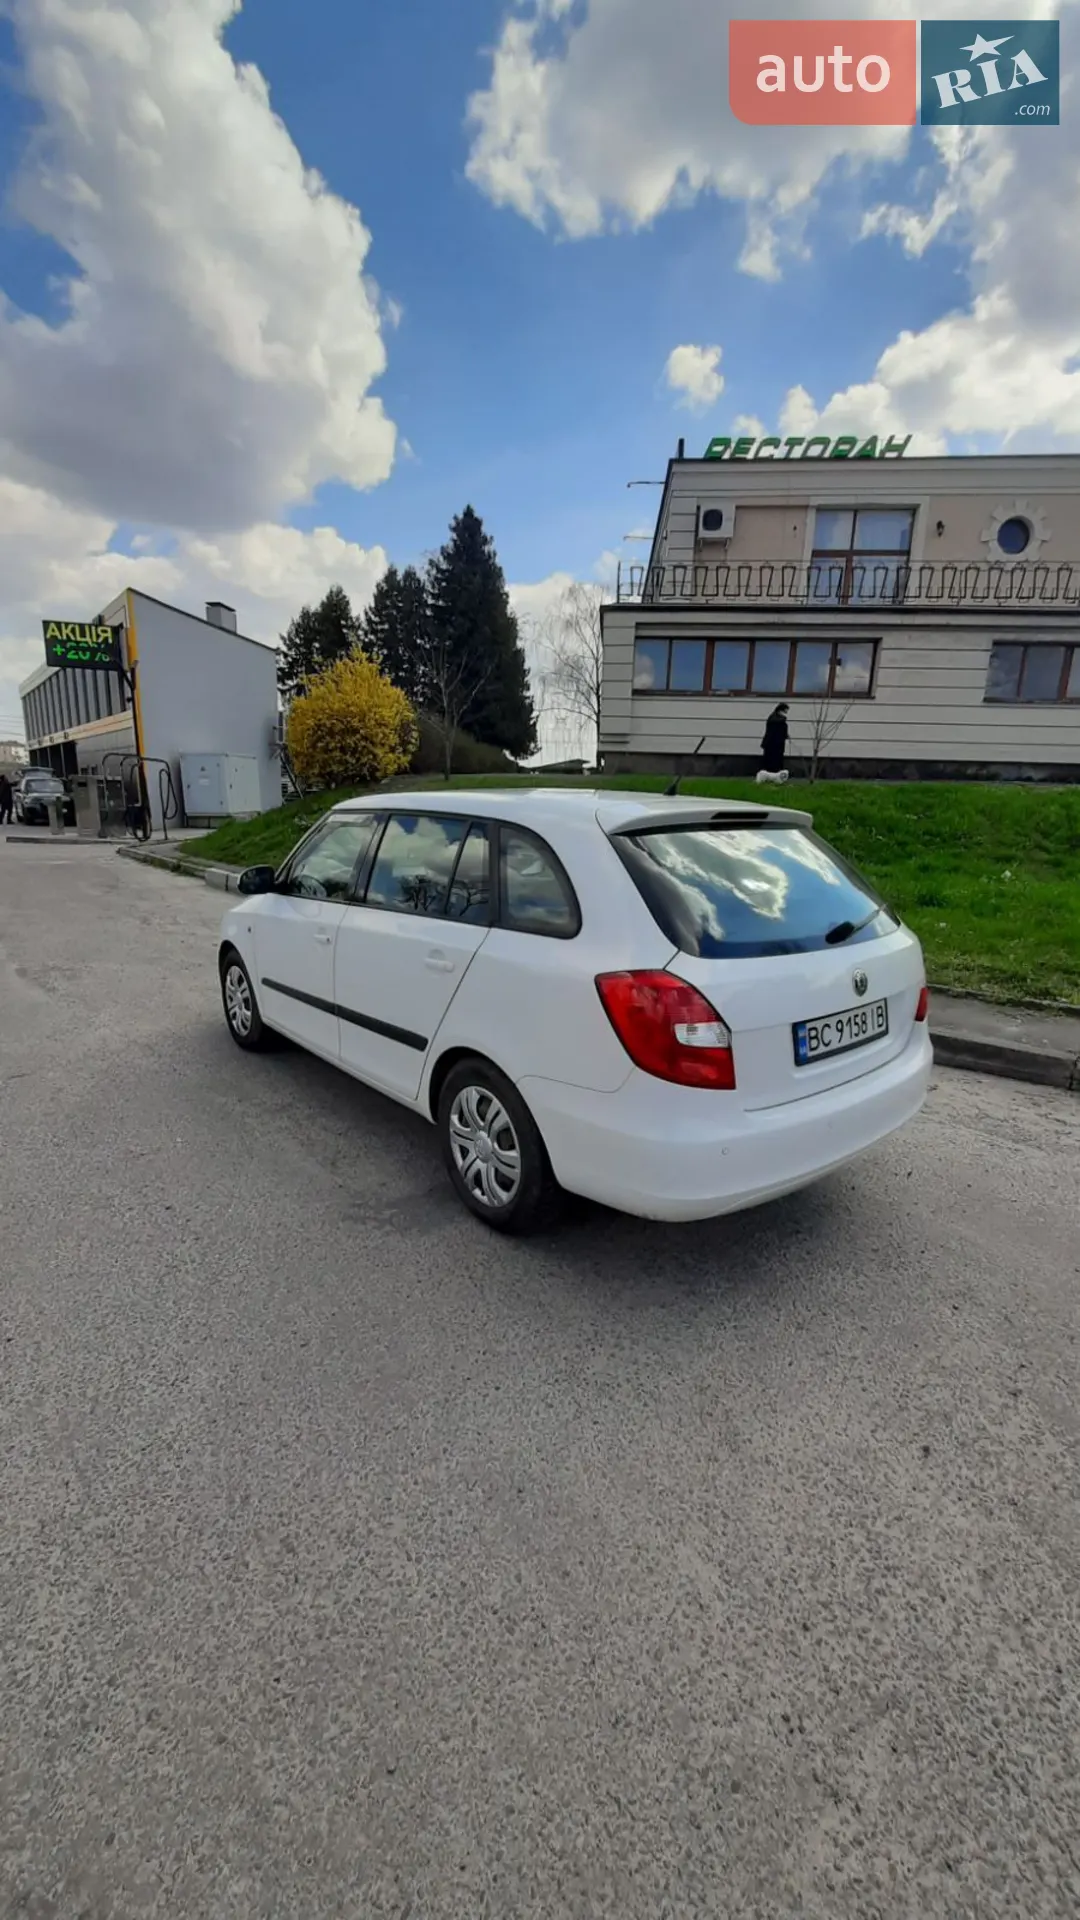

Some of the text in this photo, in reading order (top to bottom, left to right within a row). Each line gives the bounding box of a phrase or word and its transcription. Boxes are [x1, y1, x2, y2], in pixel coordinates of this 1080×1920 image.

[704, 434, 912, 459] РЕСТОРАН
[46, 622, 113, 645] АКЦІЯ
[807, 1005, 885, 1051] BC 9158 IB
